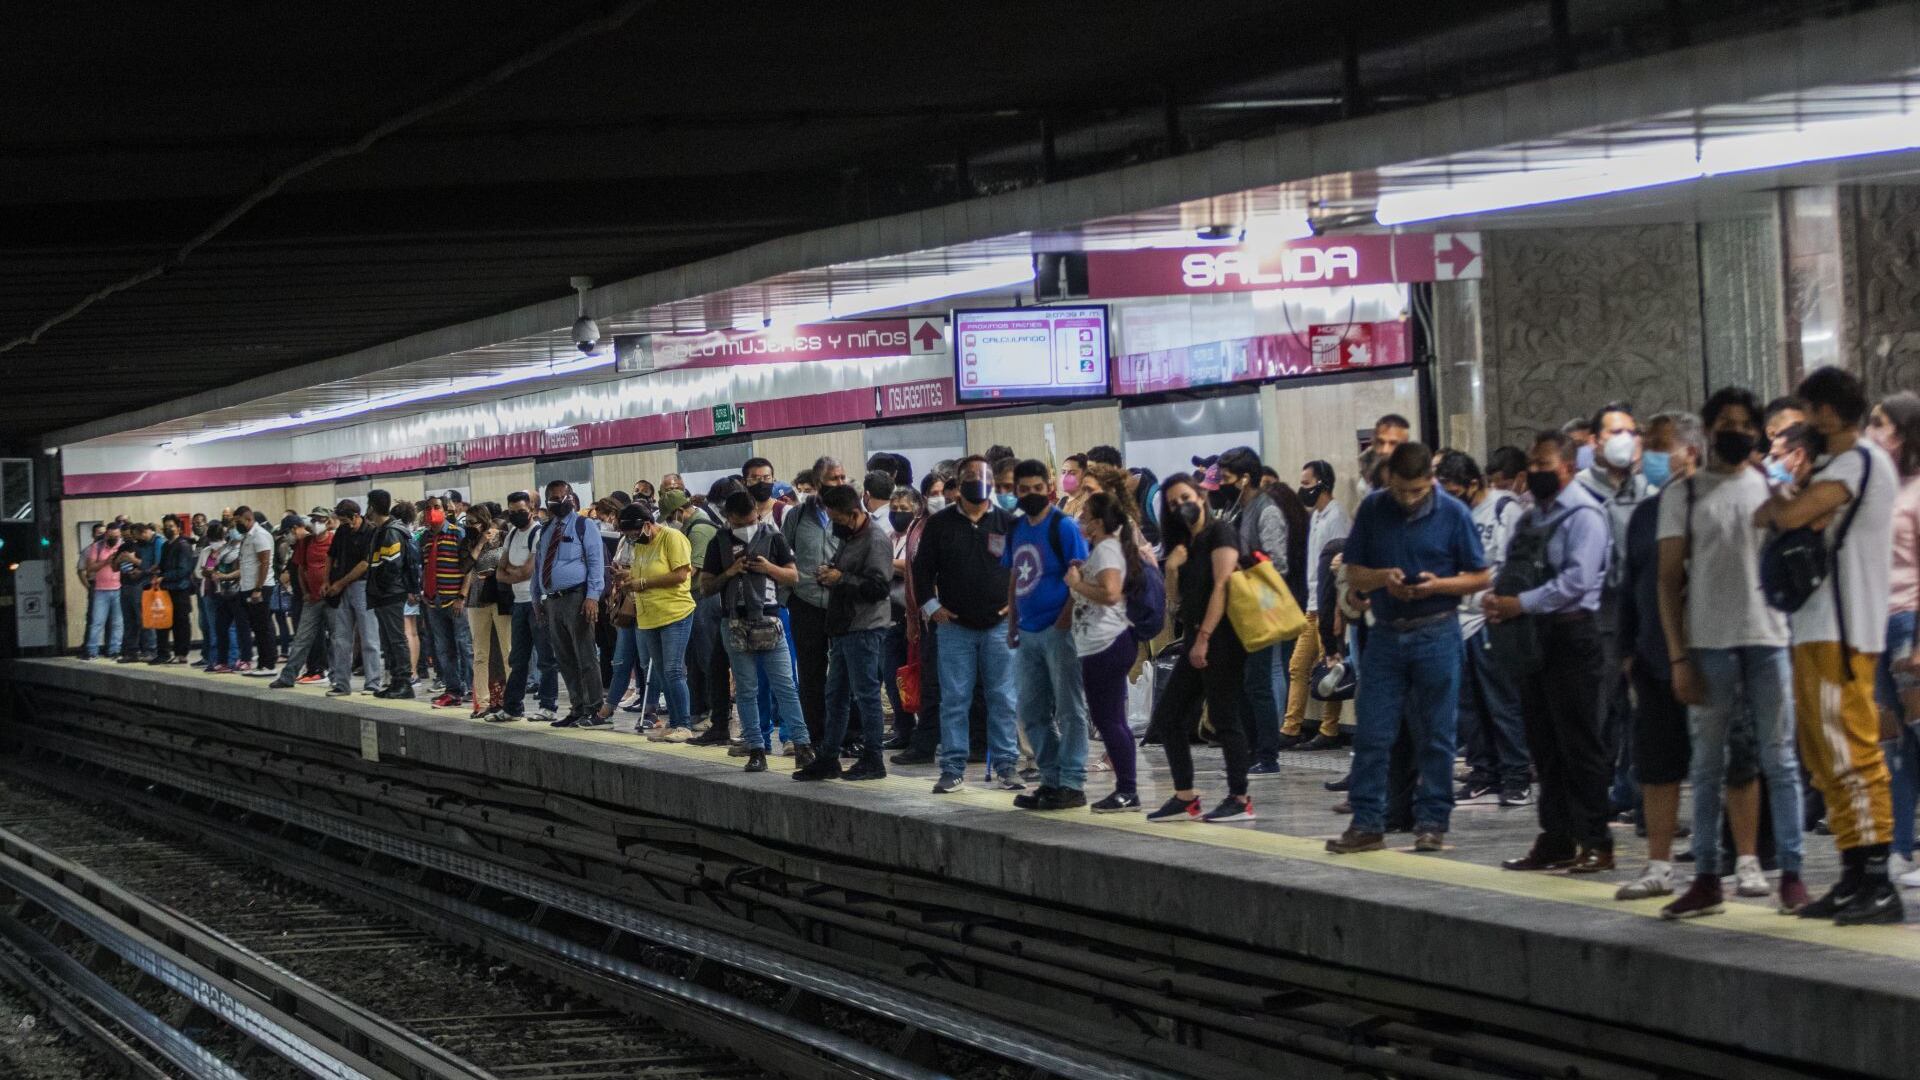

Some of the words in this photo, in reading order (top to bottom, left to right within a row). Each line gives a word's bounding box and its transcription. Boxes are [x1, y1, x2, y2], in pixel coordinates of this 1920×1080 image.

[1182, 246, 1358, 287] SALIDA
[1012, 321, 1043, 329] TRENES
[722, 335, 822, 356] MUJERES
[828, 334, 842, 349] Y
[847, 329, 907, 349] NIÑOS
[982, 335, 1046, 344] CALCULANDO
